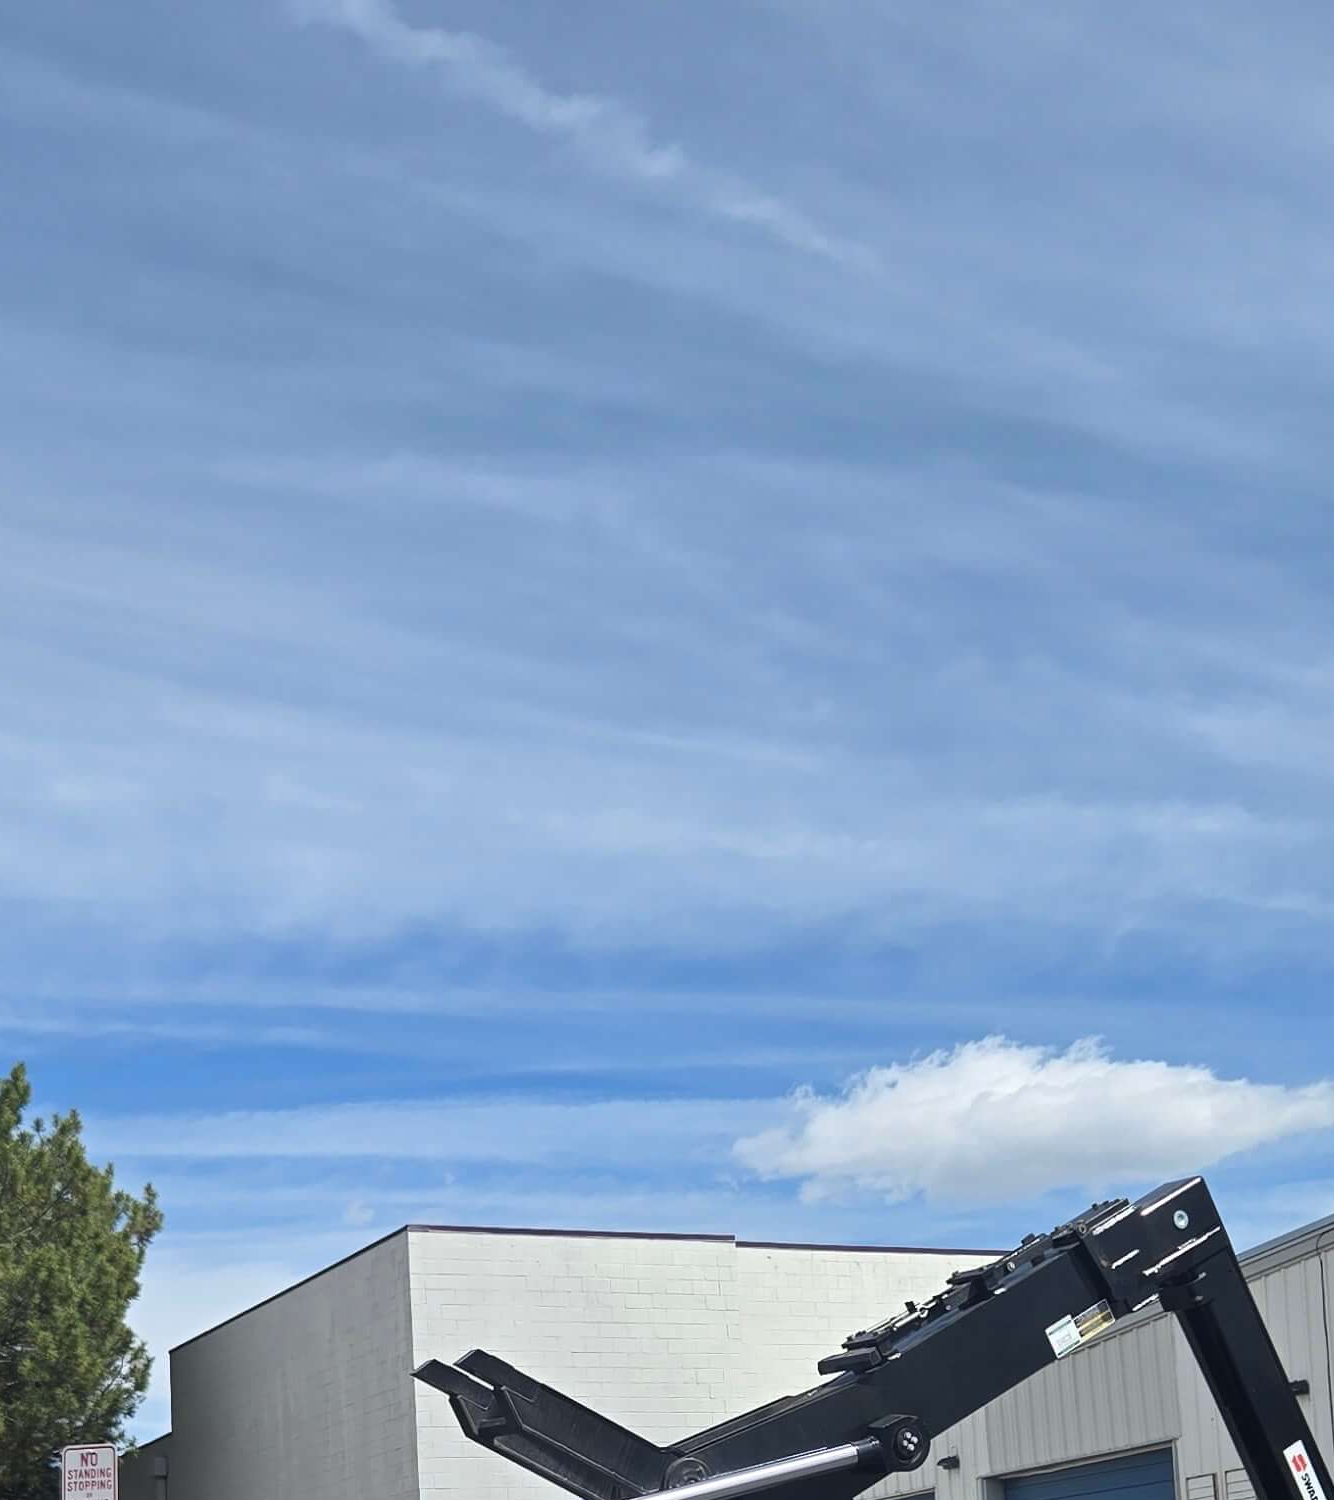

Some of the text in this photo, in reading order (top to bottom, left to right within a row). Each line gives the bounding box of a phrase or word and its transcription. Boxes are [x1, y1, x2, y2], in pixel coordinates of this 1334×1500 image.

[80, 1452, 98, 1467] NO
[67, 1467, 113, 1480] STANDING
[67, 1479, 113, 1492] STOPPING
